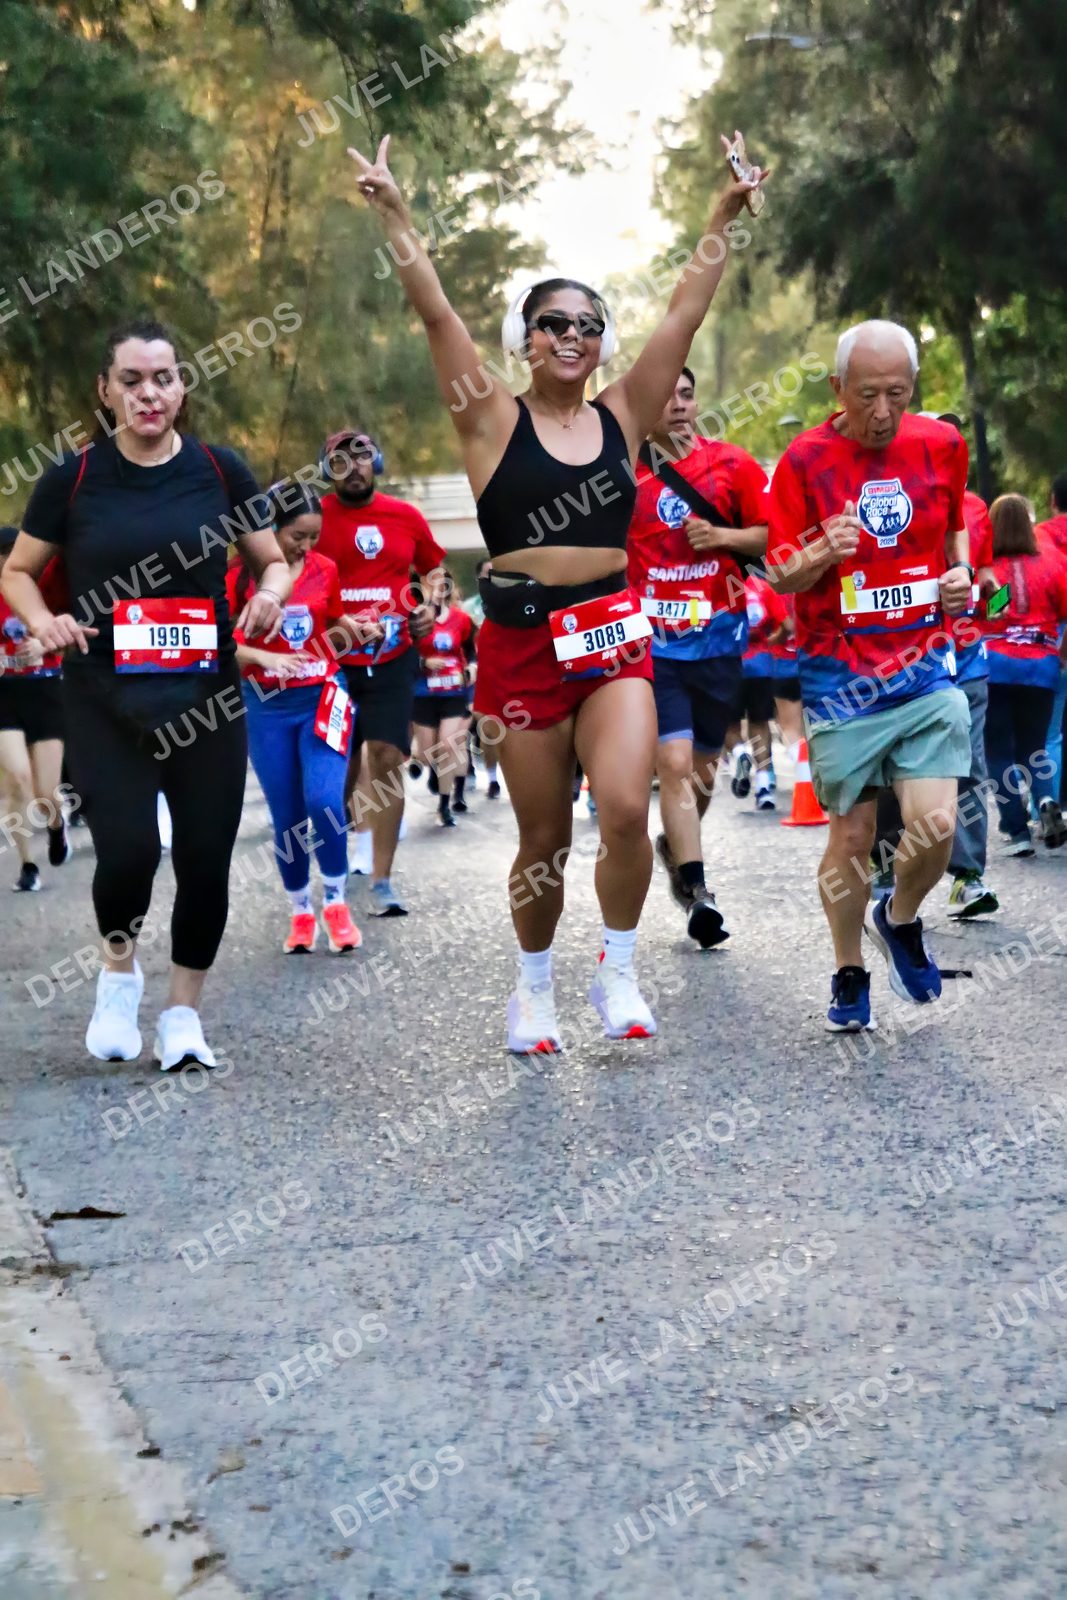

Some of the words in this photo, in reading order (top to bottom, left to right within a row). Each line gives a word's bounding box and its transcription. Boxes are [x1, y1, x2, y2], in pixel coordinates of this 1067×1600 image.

[870, 495, 897, 507] Global
[648, 560, 719, 581] SANTIAGO
[341, 586, 391, 601] SANTIAGO
[872, 586, 912, 610] 1209
[657, 602, 687, 617] 3477
[149, 626, 190, 647] 1996
[583, 622, 626, 652] 3089
